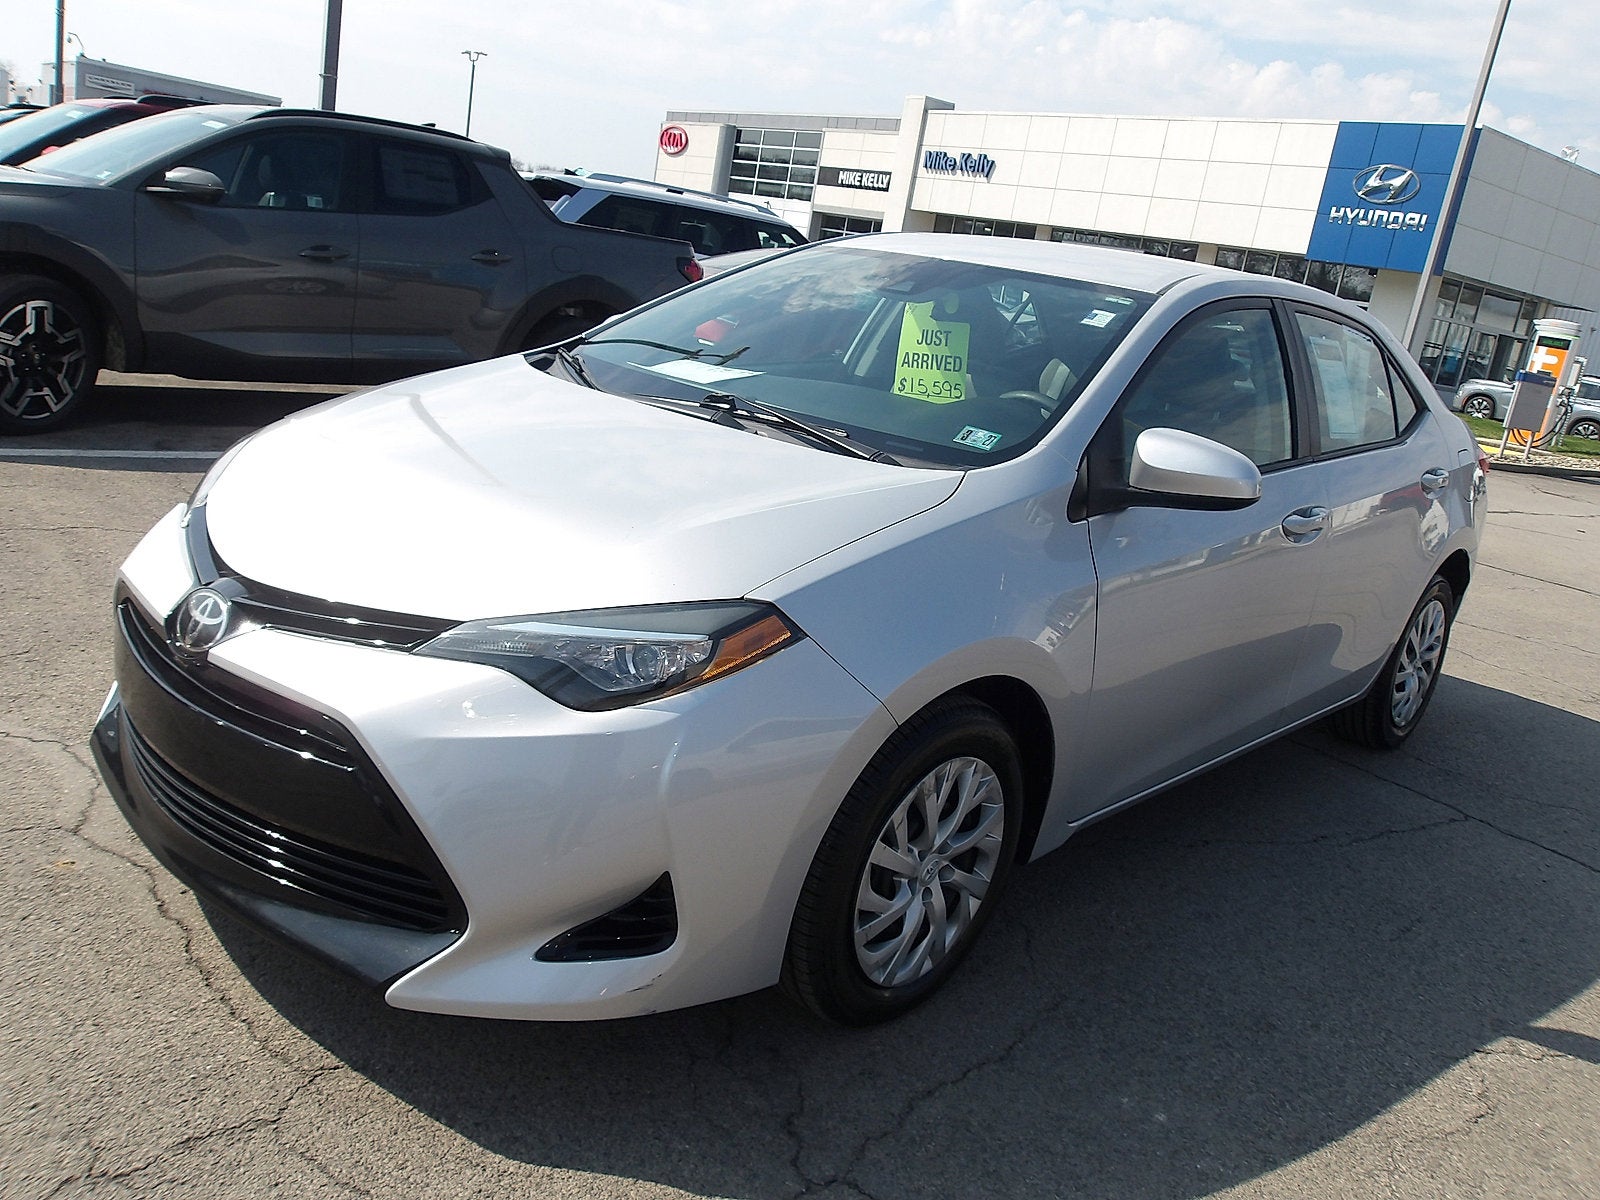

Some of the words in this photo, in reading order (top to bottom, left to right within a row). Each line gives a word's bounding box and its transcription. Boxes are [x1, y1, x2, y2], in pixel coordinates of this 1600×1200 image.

[662, 131, 684, 148] KIA
[923, 151, 956, 172] Mike
[958, 153, 995, 180] Kelly
[838, 171, 861, 186] MIKE
[861, 172, 890, 189] KELLY
[1329, 206, 1428, 232] HYUNDAI
[917, 329, 952, 347] JUST
[901, 352, 963, 373] ARRIVED
[898, 377, 963, 399] $15,595
